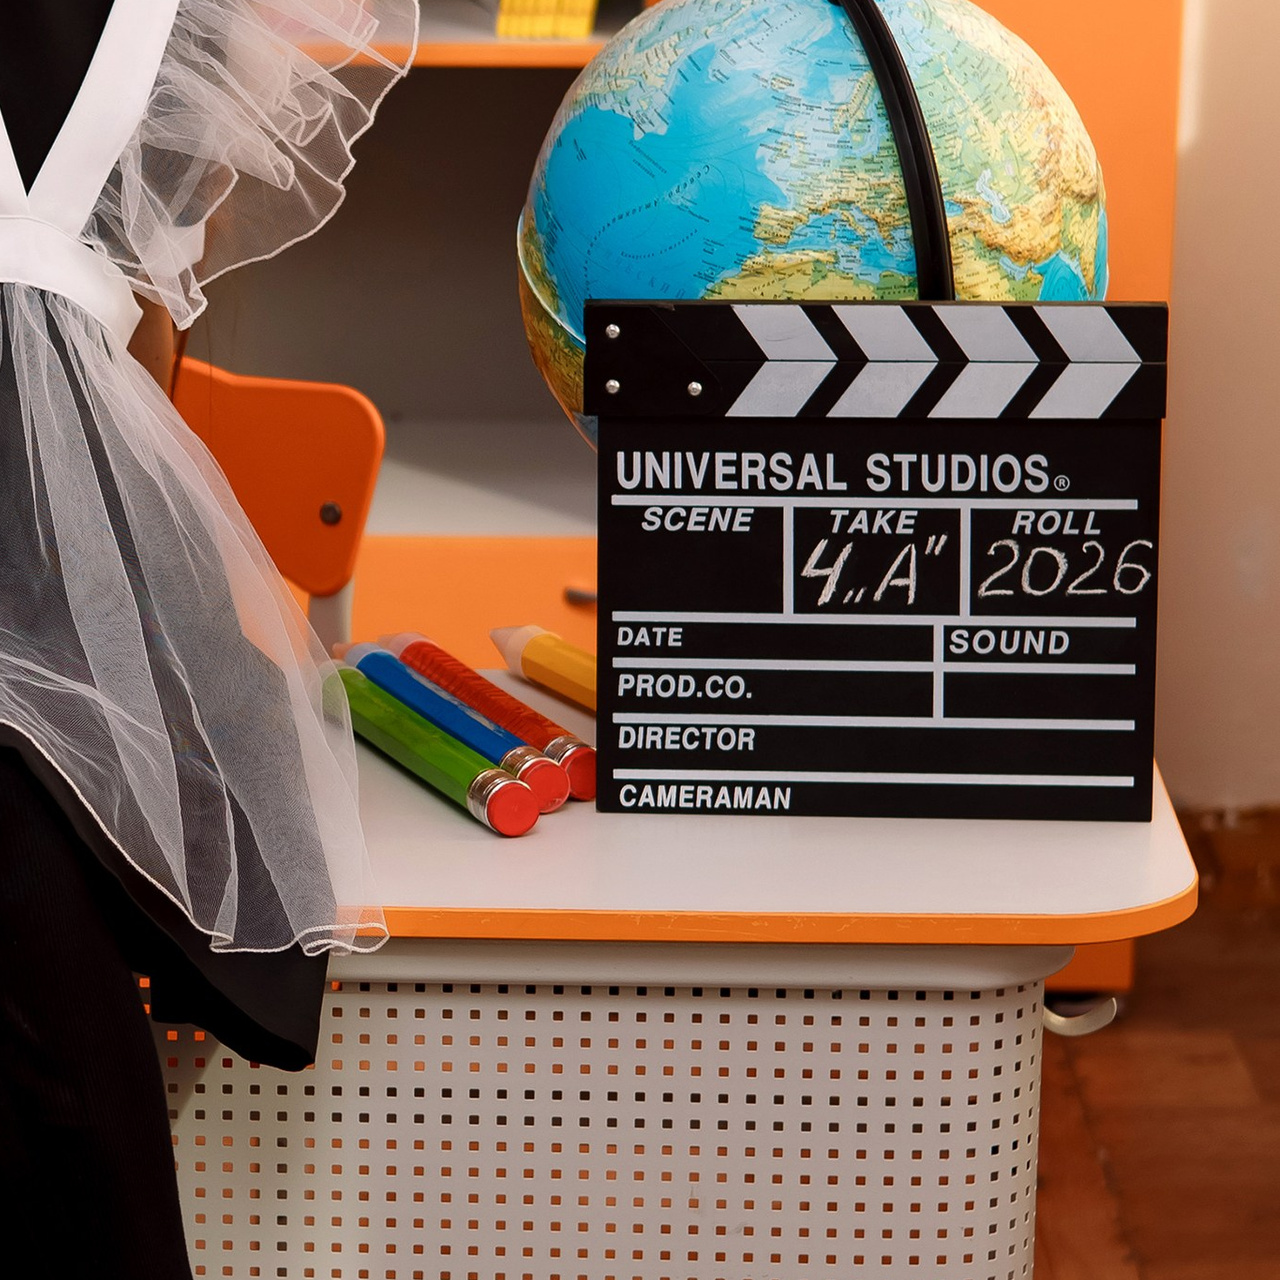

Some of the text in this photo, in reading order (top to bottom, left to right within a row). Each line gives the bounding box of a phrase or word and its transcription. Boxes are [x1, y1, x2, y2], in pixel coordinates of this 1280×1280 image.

[616, 451, 848, 491] UNIVERSAL
[641, 507, 754, 532] SCENE
[830, 510, 919, 535] TAKE
[1011, 510, 1102, 536] ROLL
[977, 539, 1153, 600] 2026
[617, 626, 683, 647] DATE
[949, 629, 1070, 655] SOUND
[617, 673, 753, 699] PROD.CO.
[618, 725, 756, 752] DIRECTOR
[619, 784, 791, 810] CAMERAMAN
